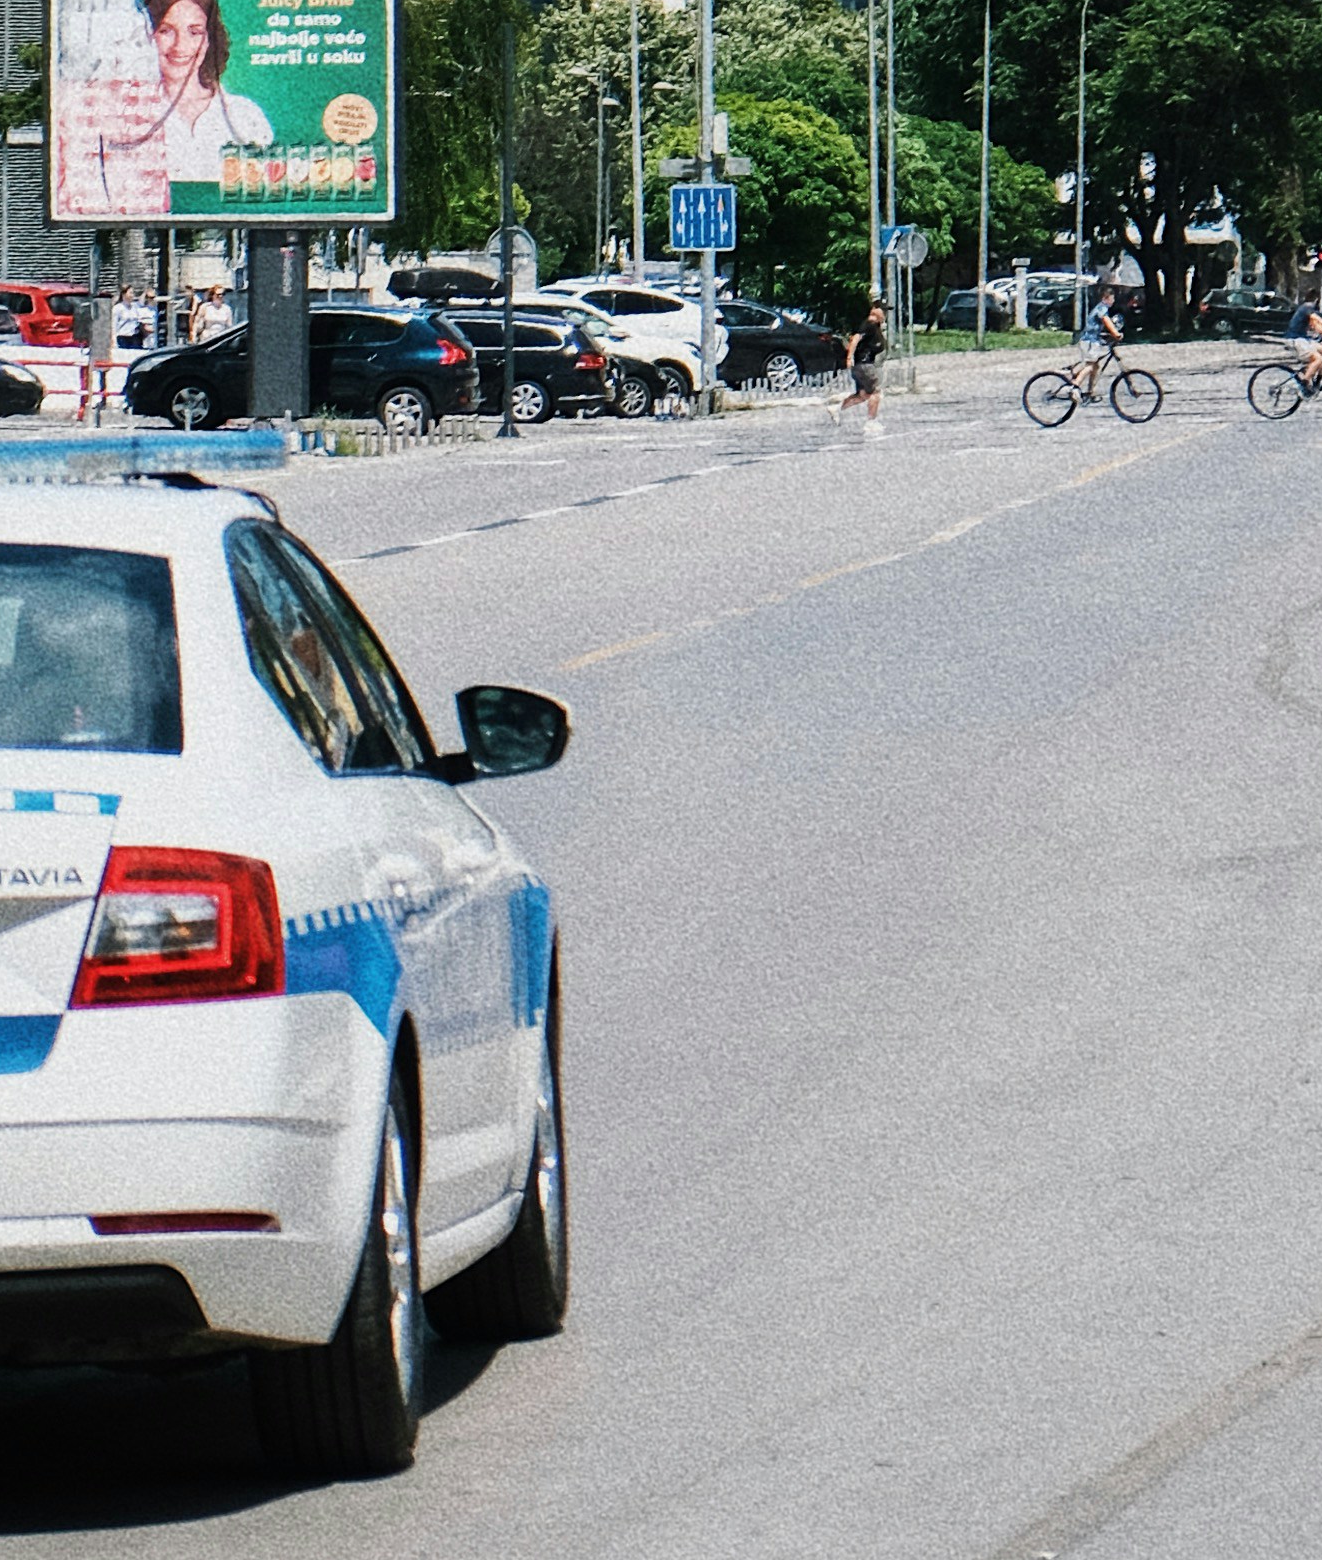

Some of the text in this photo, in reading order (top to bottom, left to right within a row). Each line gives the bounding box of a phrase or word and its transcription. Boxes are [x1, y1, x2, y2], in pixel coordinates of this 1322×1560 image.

[266, 11, 342, 27] da samo
[248, 29, 320, 48] najbolje
[306, 52, 318, 64] u
[322, 49, 366, 64] soku
